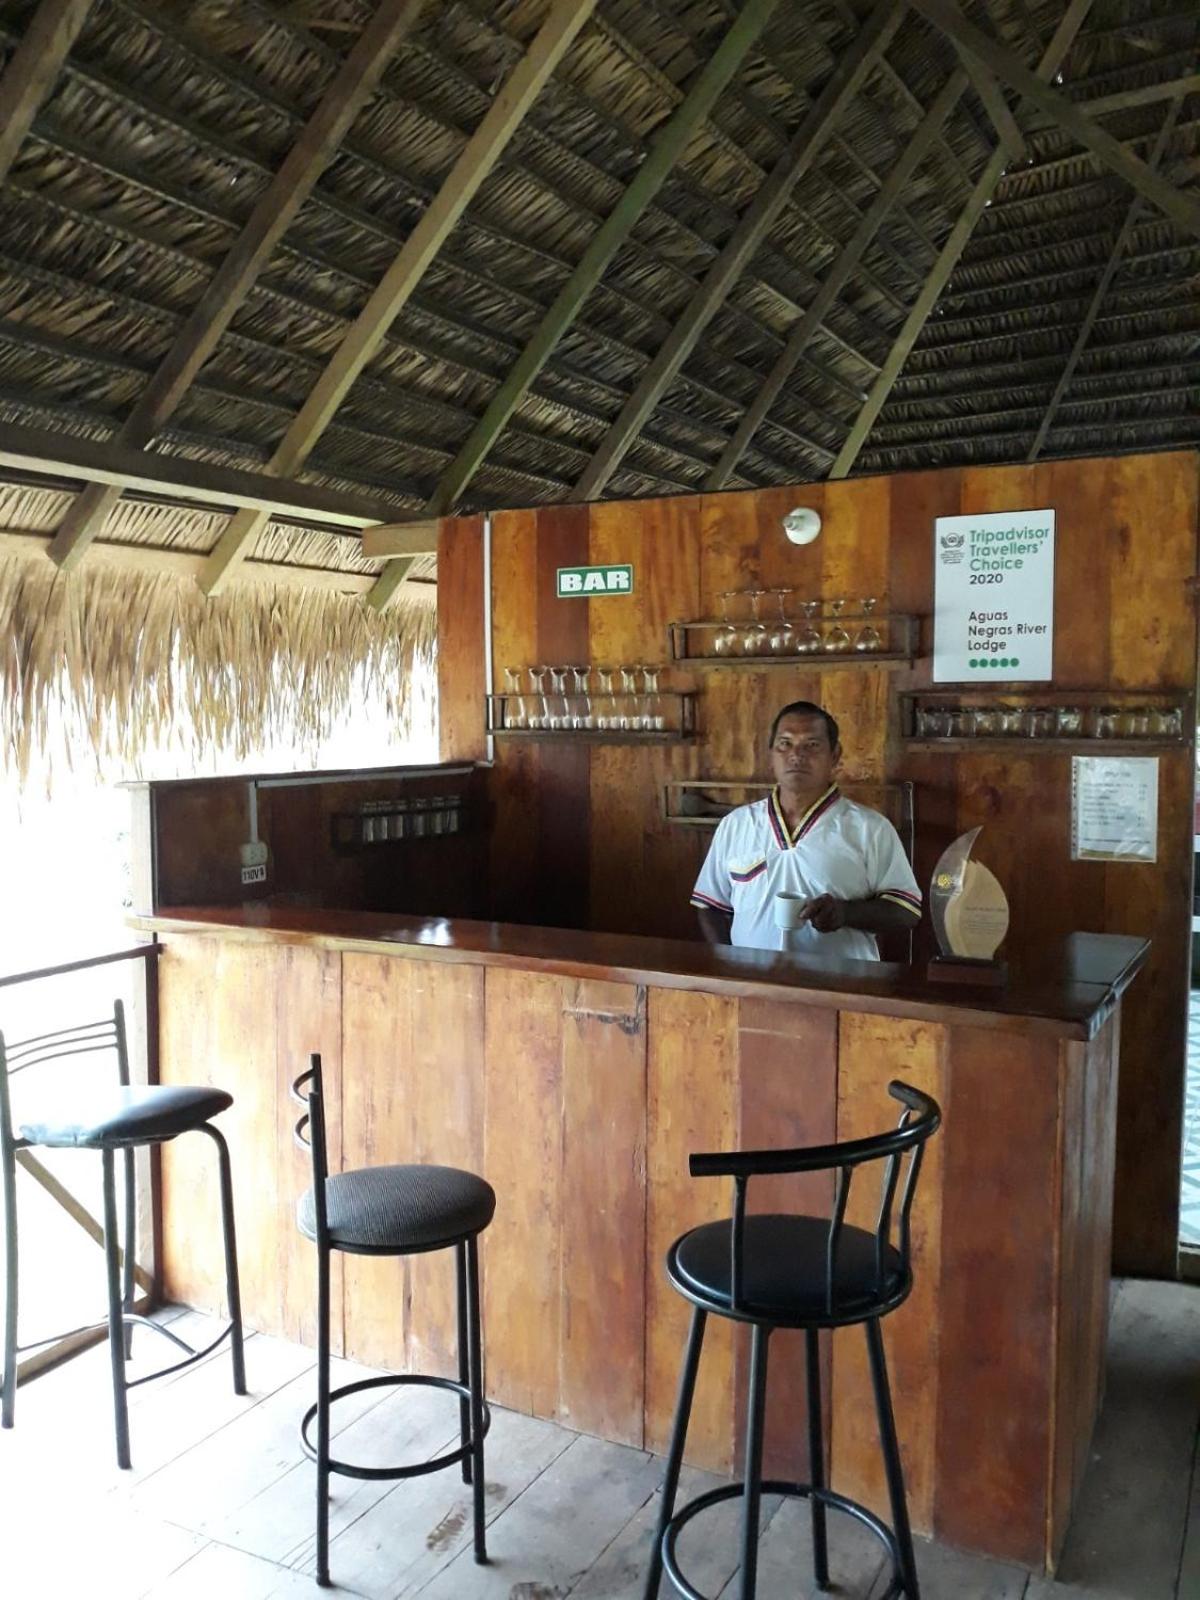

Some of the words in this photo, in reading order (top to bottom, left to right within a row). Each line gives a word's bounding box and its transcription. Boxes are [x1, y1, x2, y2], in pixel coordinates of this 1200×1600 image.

[970, 527, 1050, 545] Tripadvisor
[970, 557, 1024, 571] Choice
[560, 571, 629, 592] BAR
[970, 573, 1003, 585] 2020
[968, 611, 1008, 624] Aguas
[968, 624, 1013, 638] Negras
[1017, 623, 1048, 635] River
[968, 640, 1007, 652] Lodge
